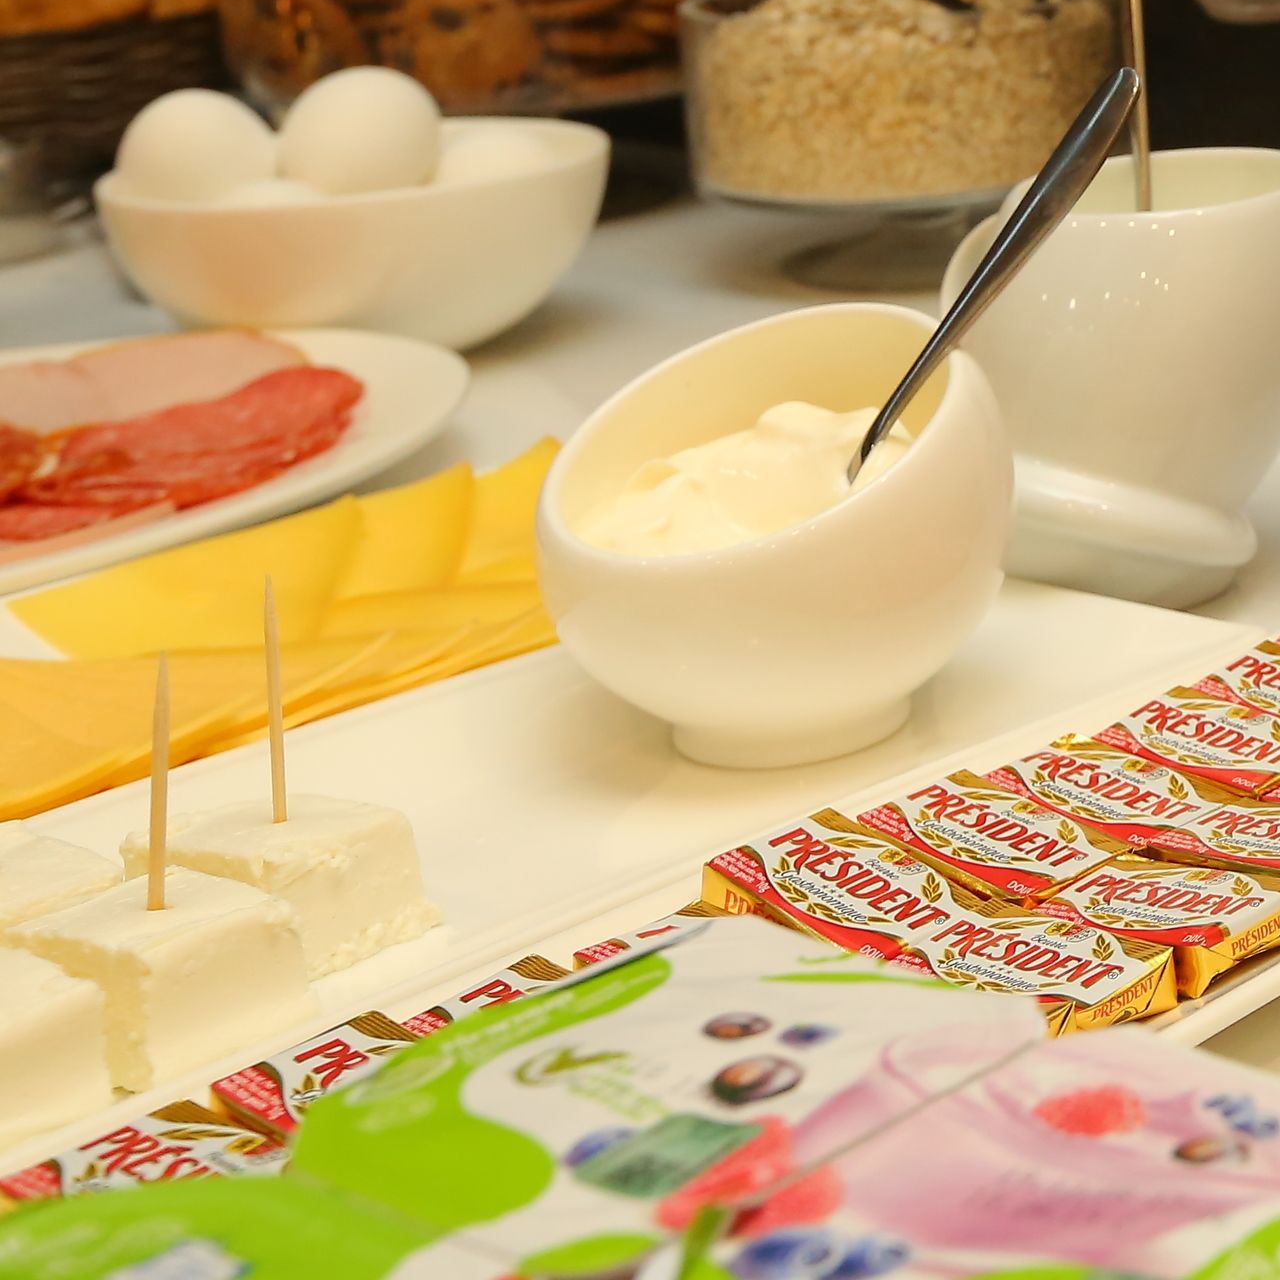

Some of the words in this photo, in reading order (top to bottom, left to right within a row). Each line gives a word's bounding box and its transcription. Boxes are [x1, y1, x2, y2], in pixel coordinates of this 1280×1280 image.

[1022, 751, 1201, 820] PRÉSIDENT
[907, 784, 1089, 867] PRÉSIDENT
[916, 818, 1011, 863] Gastronomique
[768, 827, 951, 931] PRÉSIDENT
[773, 870, 869, 924] Gastronomique
[1075, 872, 1266, 917] PRÉSIDENT
[930, 919, 1125, 990] PRÉSIDENT
[938, 956, 1039, 991] Gastronomique
